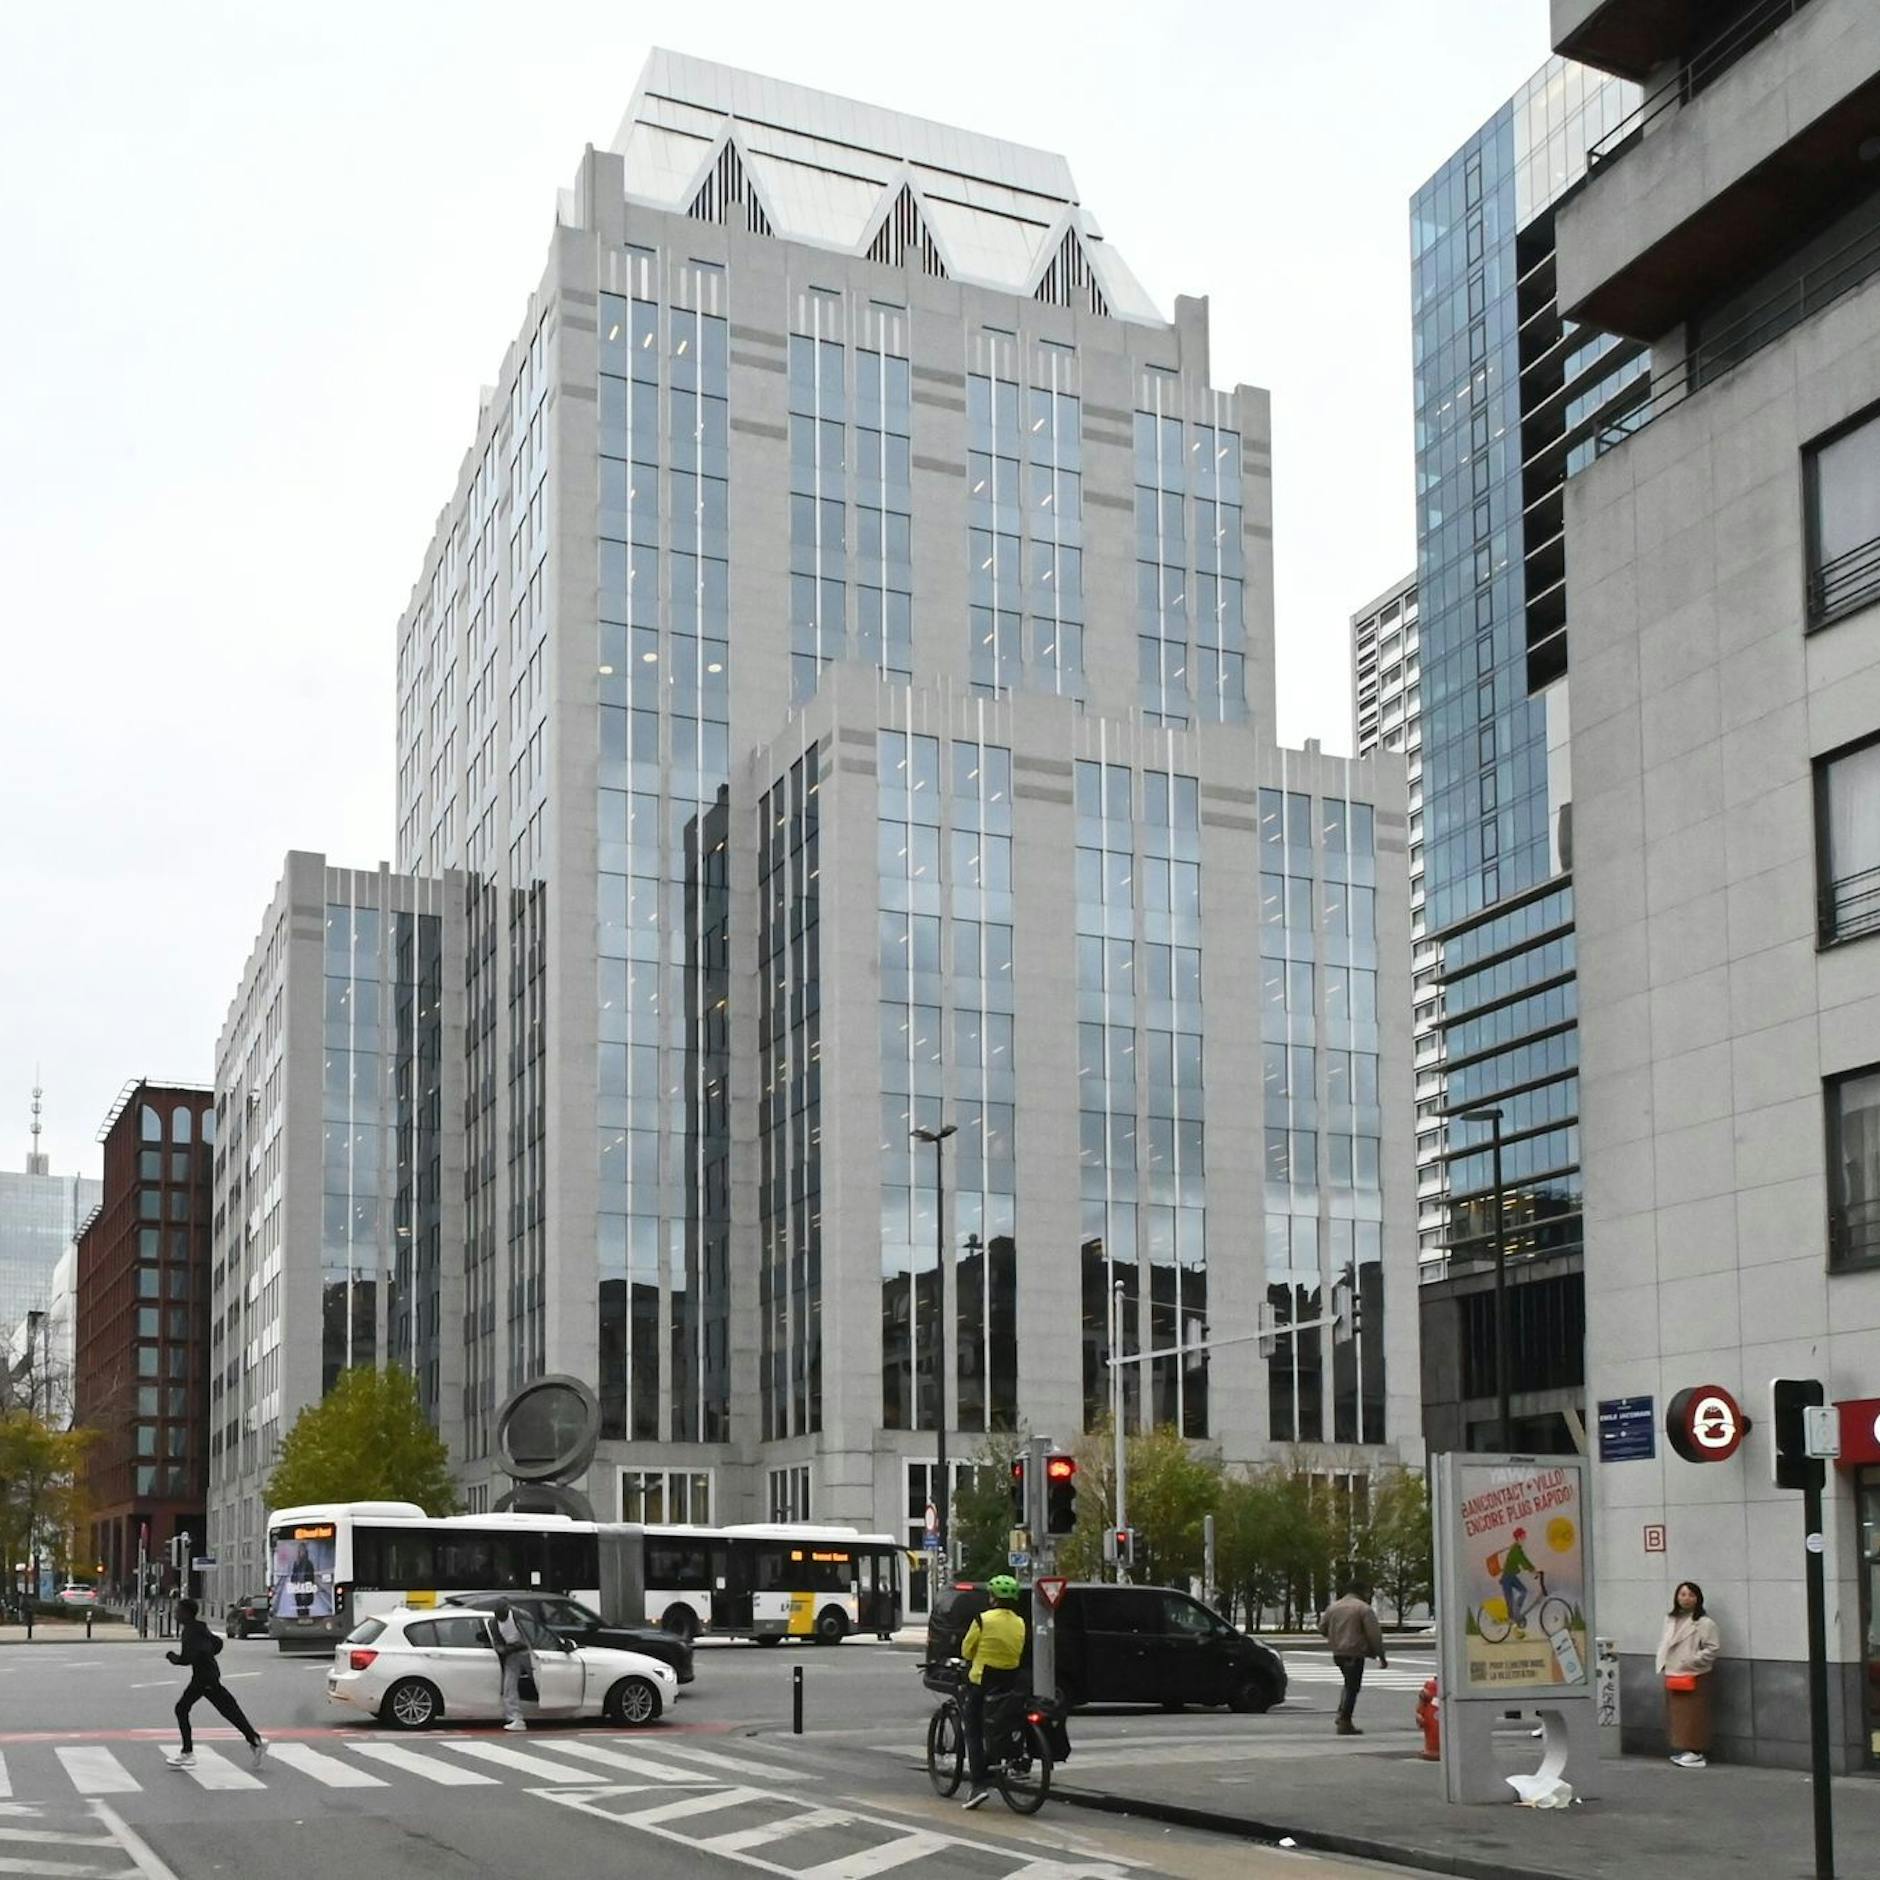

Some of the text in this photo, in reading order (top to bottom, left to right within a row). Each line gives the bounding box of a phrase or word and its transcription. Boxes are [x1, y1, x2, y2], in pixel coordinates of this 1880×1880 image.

[1461, 1482, 1525, 1519] BANCONTACT
[1465, 1509, 1505, 1537] ENCORE
[1506, 1500, 1533, 1523] PLUS
[1649, 1530, 1661, 1547] B
